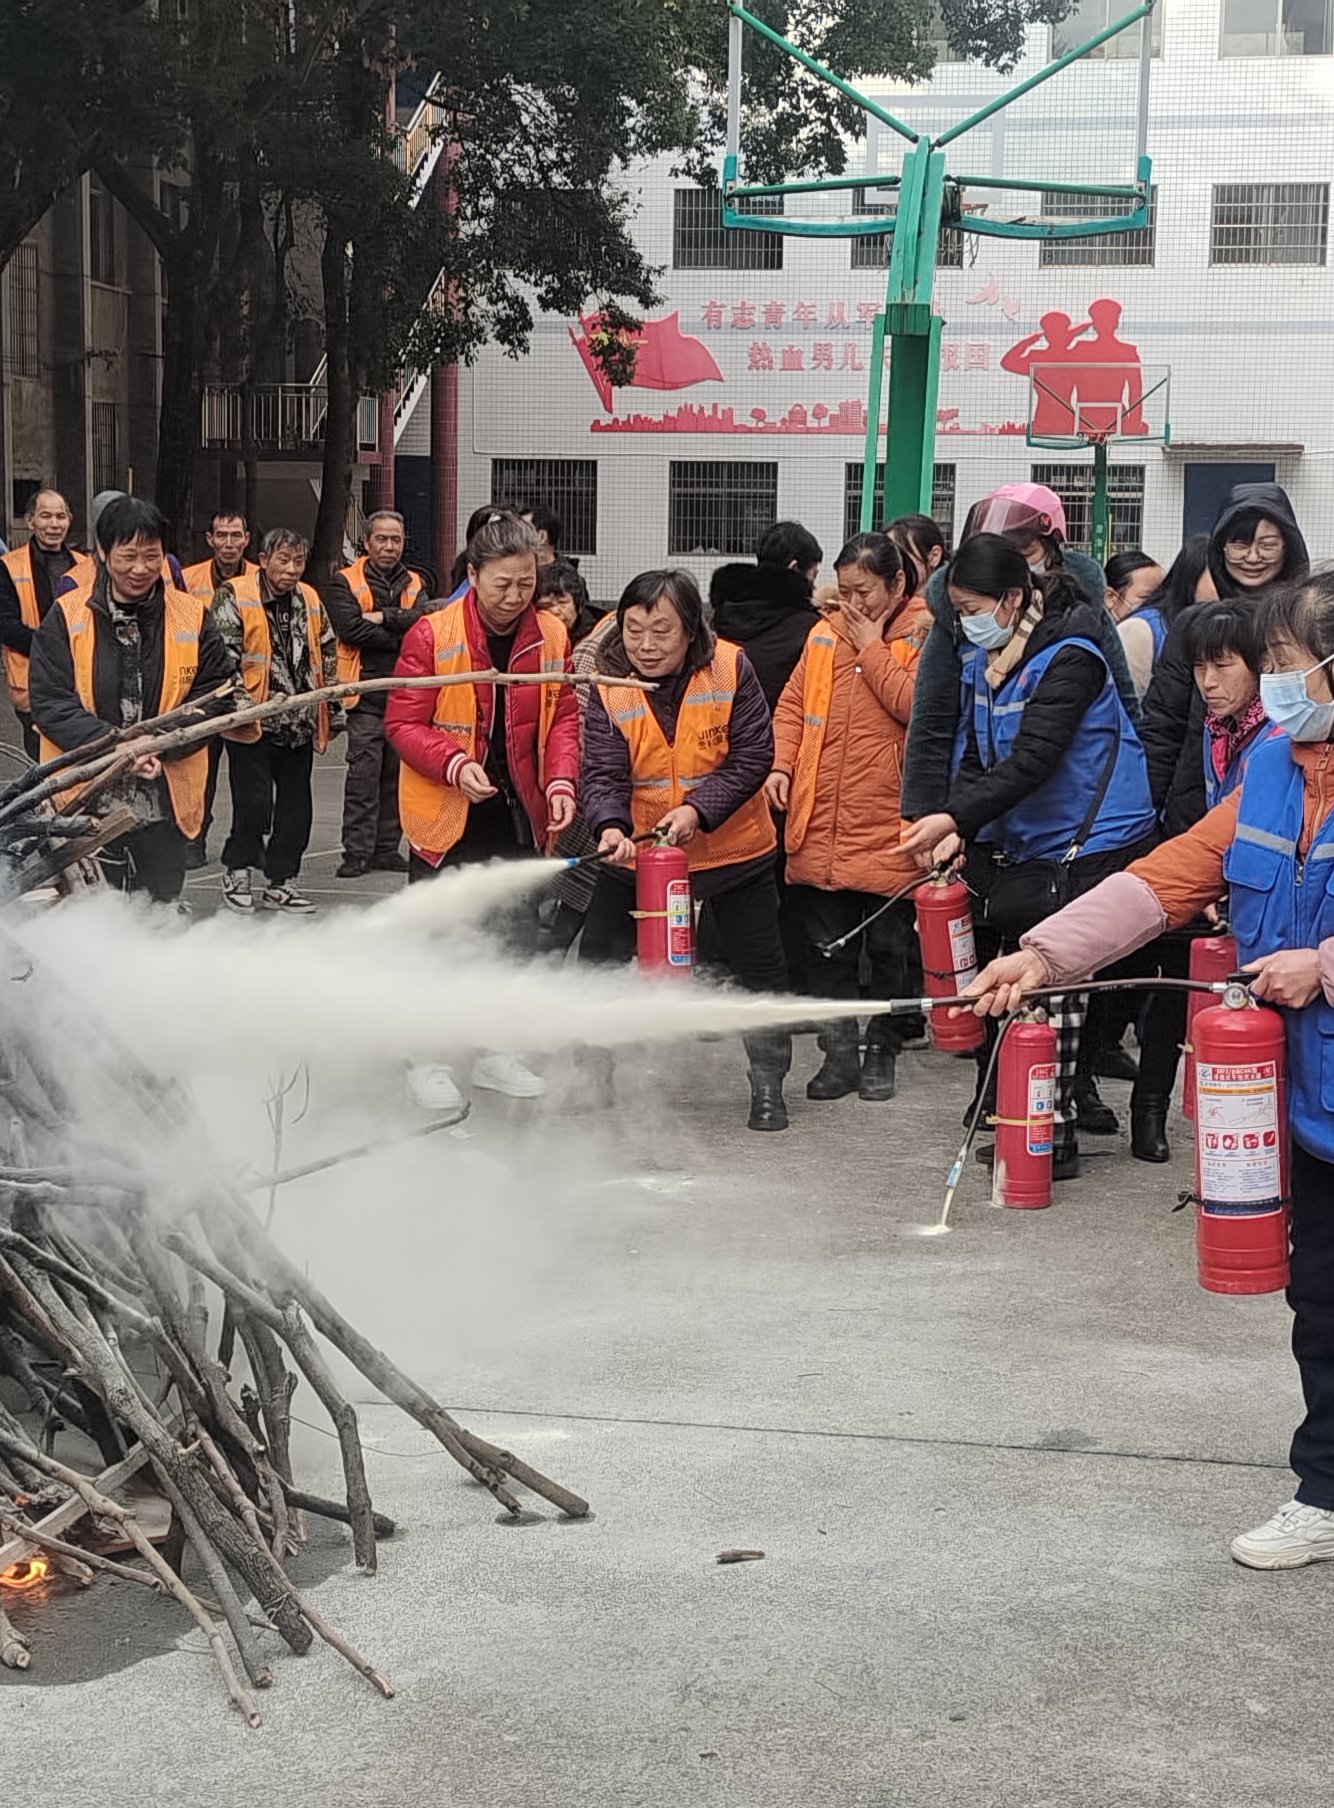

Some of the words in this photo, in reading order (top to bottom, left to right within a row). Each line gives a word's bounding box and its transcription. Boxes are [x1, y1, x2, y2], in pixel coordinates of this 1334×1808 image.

[700, 300, 946, 330] 有志青年从军
[747, 341, 990, 371] 热血男儿报国
